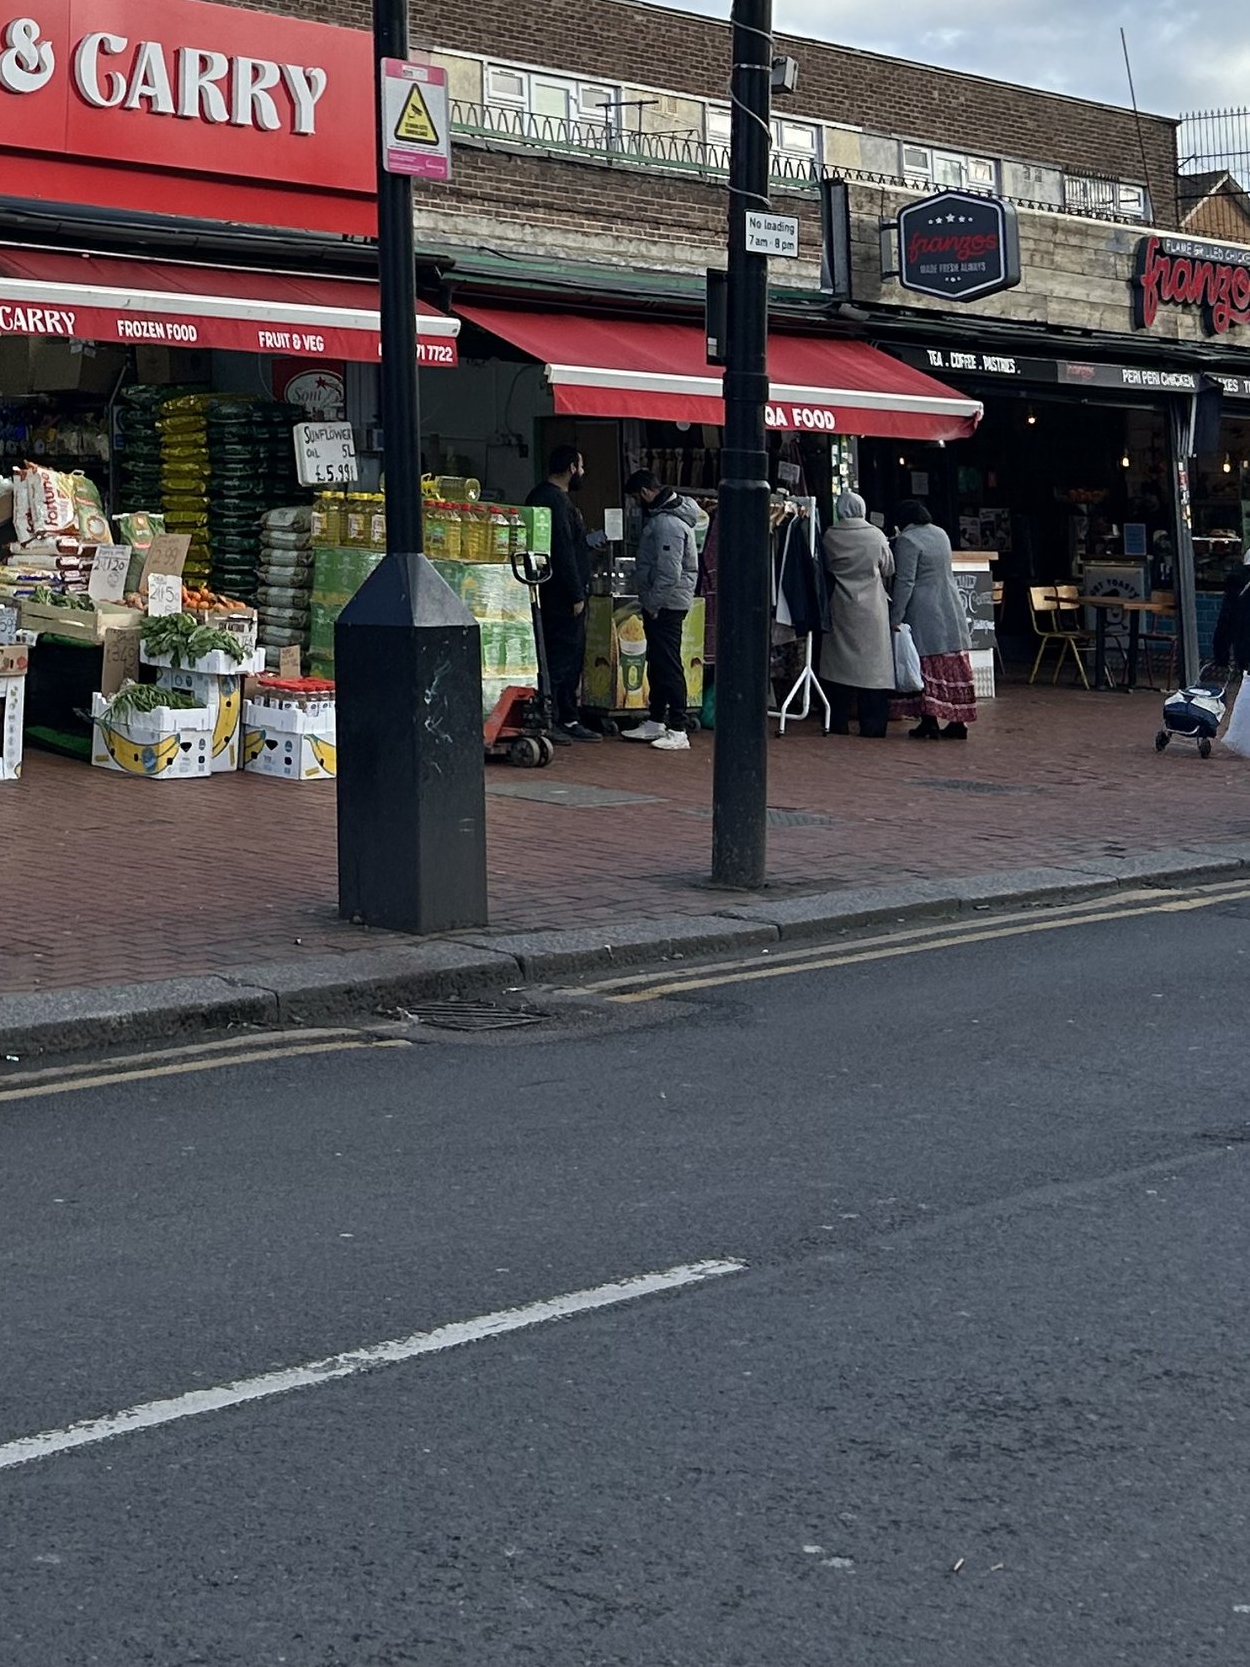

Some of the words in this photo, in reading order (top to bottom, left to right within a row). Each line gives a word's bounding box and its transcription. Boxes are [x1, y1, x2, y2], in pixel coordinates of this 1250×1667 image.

[74, 31, 327, 135] CARRY
[749, 217, 761, 229] No
[764, 219, 795, 236] loading
[919, 264, 938, 274] MADE
[939, 262, 959, 273] FRESH
[960, 261, 987, 272] ALWAYS
[117, 319, 165, 339] FROZEN
[166, 323, 198, 342] FOOD
[258, 330, 291, 349] FRUIT
[292, 334, 301, 351] &
[302, 334, 324, 352] VEG
[427, 345, 453, 362] 7722
[926, 349, 944, 367] TEA
[950, 351, 977, 370] COFFEE
[1121, 368, 1141, 384] PERI
[1141, 370, 1160, 385] PERI
[1160, 372, 1196, 388] CHICKEN
[792, 407, 836, 430] FOOD
